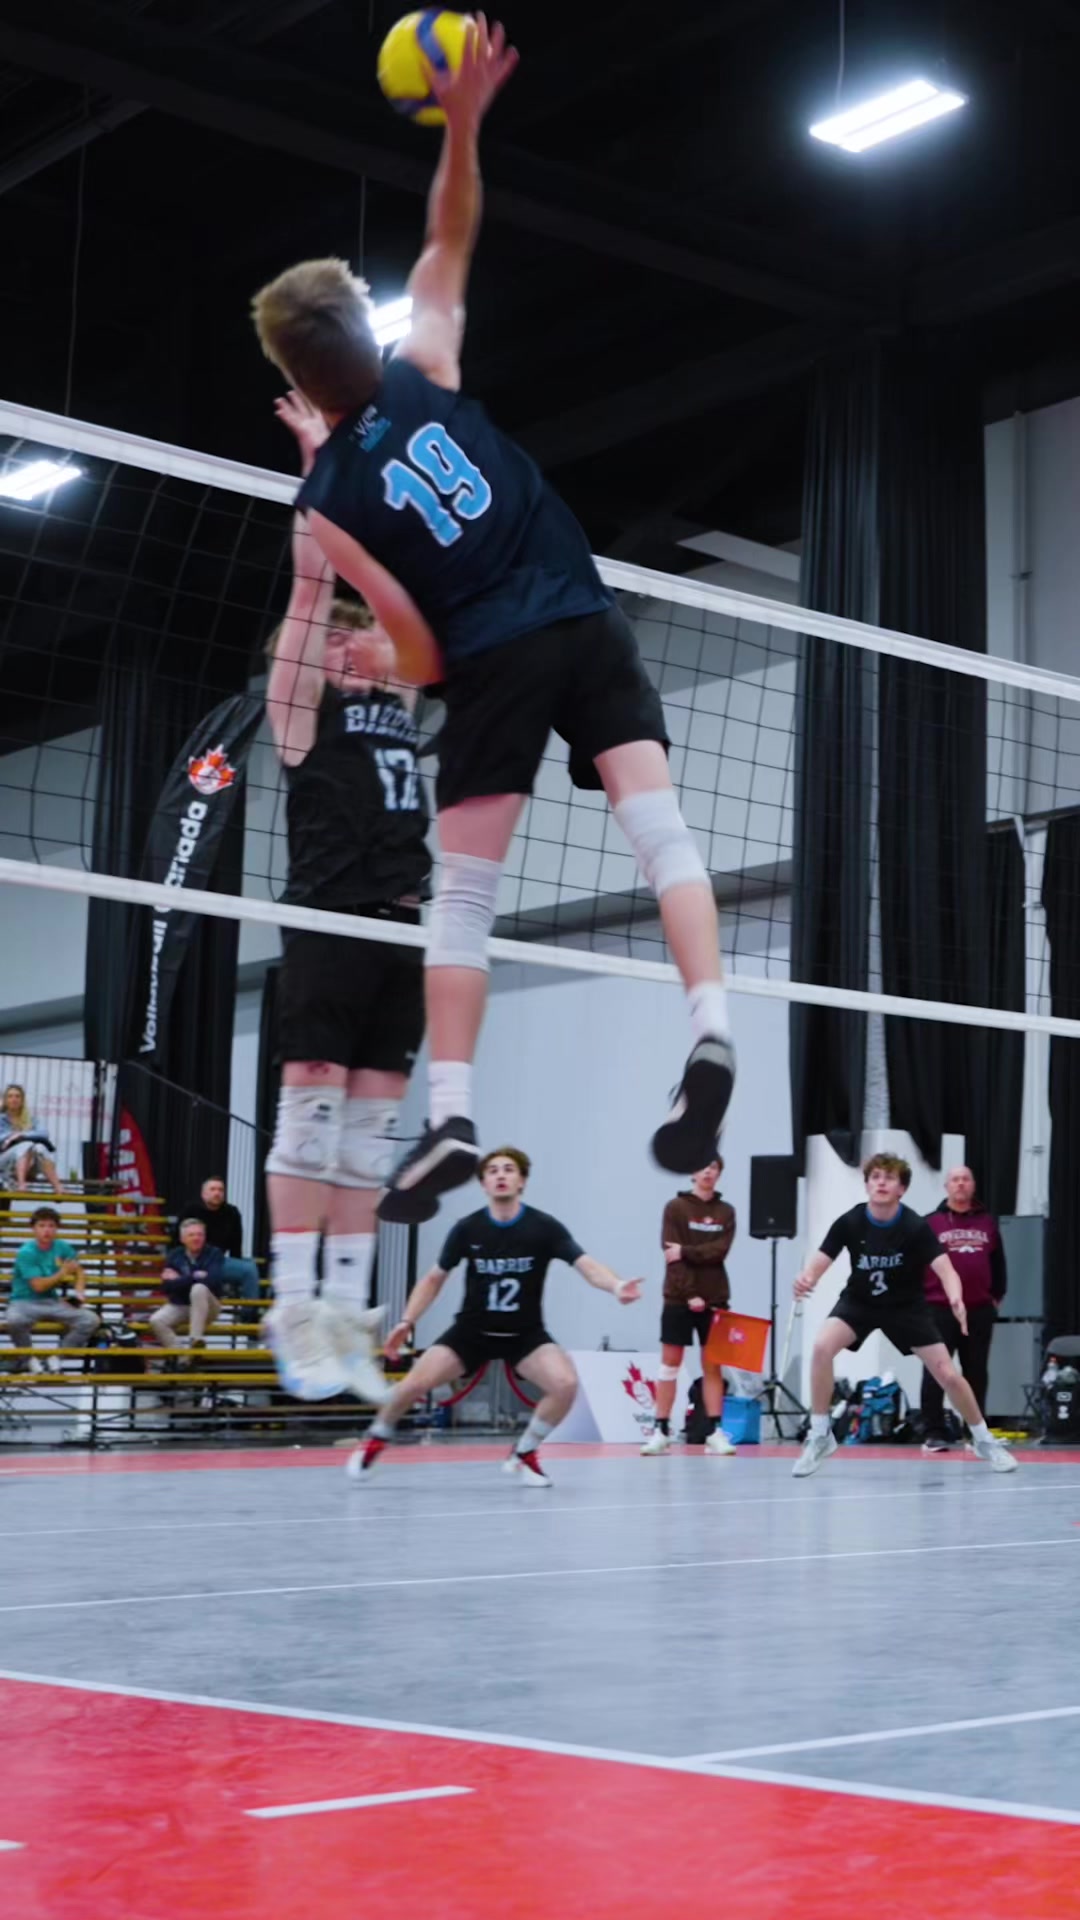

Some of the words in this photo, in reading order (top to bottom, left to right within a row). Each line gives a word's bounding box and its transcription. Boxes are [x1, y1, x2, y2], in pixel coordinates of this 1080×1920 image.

[381, 421, 492, 547] 19
[153, 800, 209, 913] anada
[474, 1256, 535, 1275] BARRIE
[856, 1253, 904, 1270] ARRIE
[486, 1278, 521, 1312] 12
[869, 1270, 889, 1297] 3
